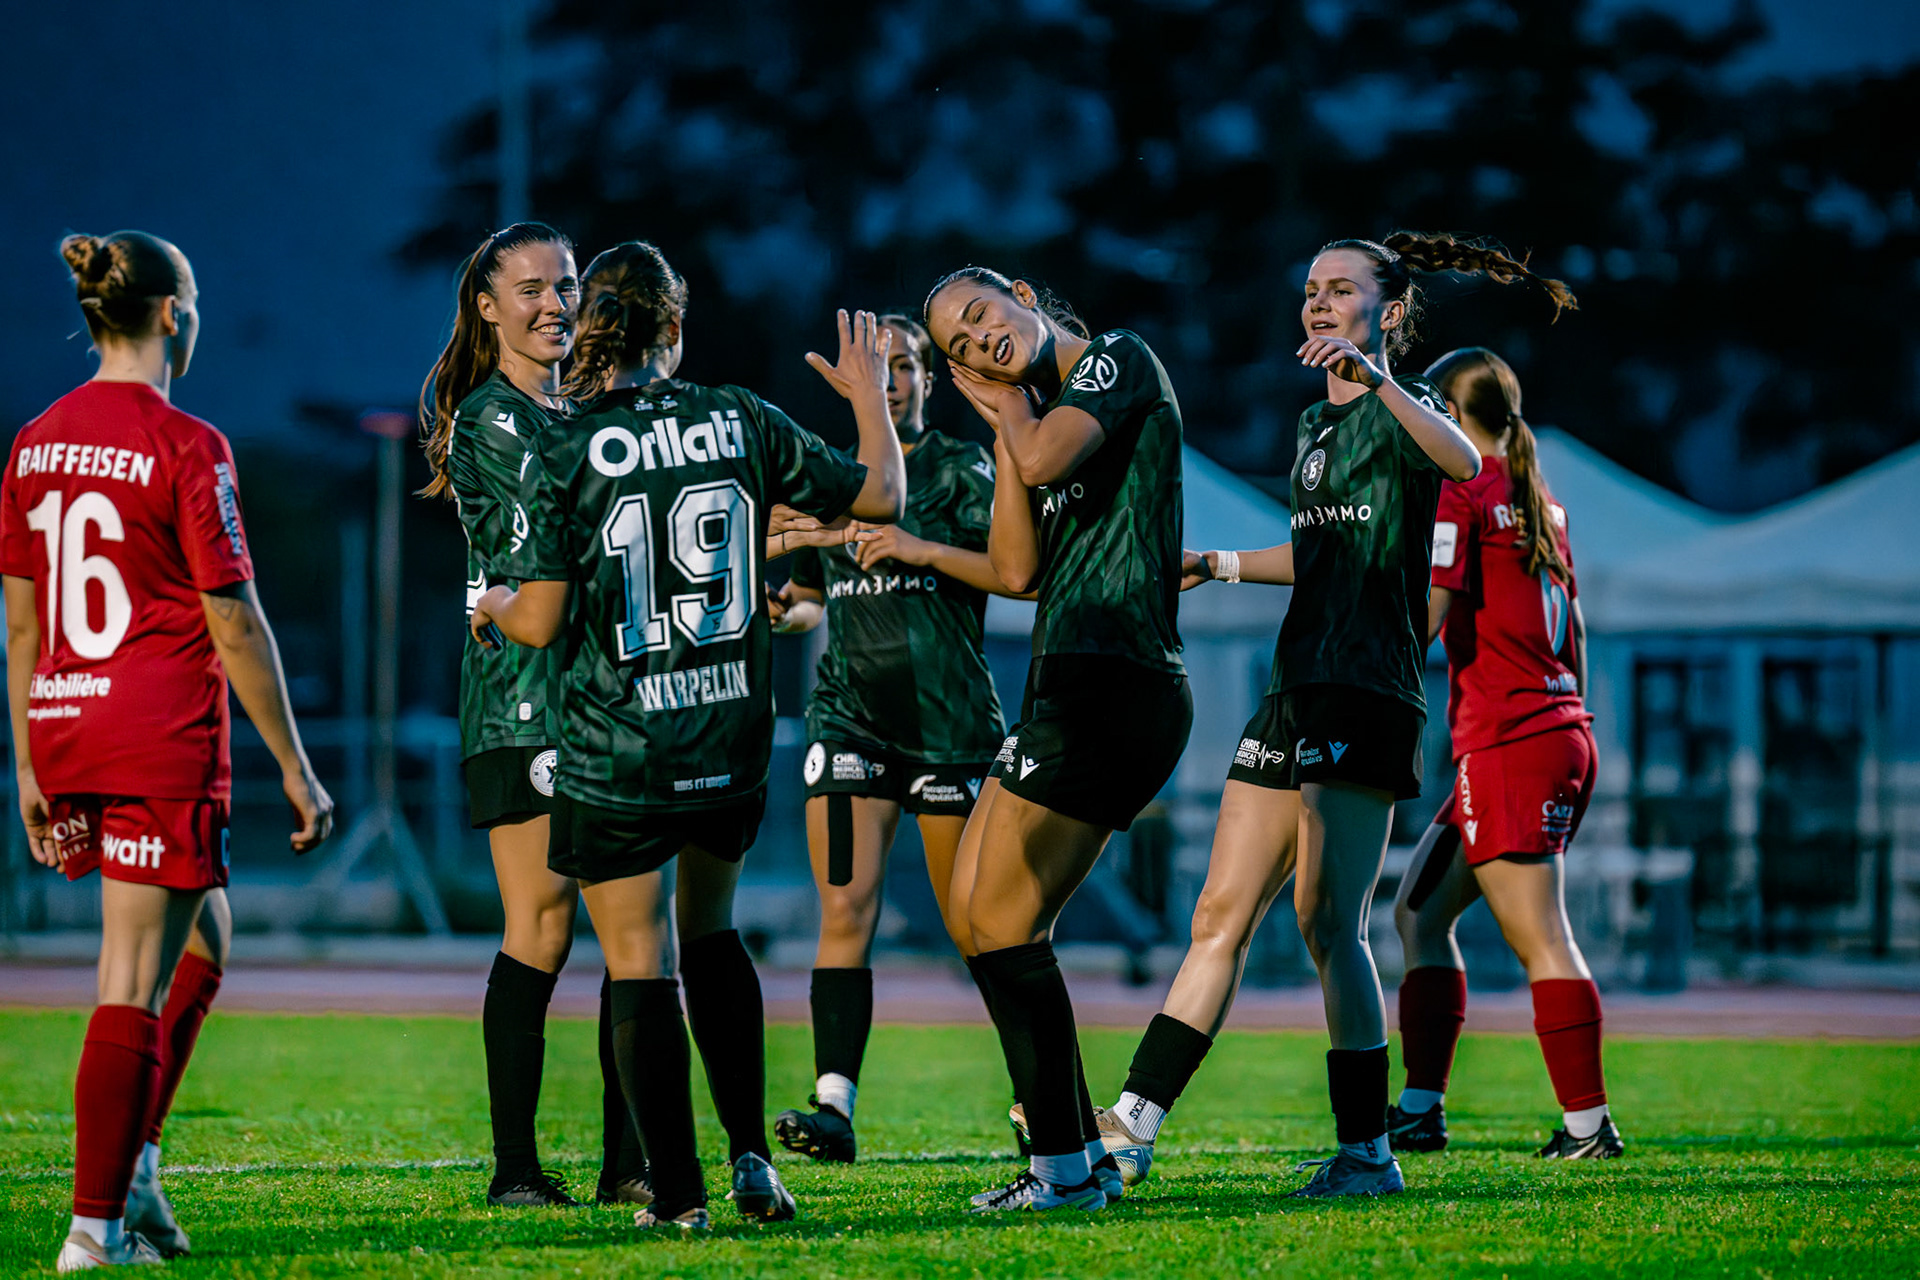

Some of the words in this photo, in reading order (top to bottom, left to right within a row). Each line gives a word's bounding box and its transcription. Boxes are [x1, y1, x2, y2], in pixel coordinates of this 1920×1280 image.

[17, 442, 154, 487] RAIFFEISEN
[588, 409, 746, 477] Orllati
[26, 490, 133, 660] 16
[602, 478, 757, 661] 19
[634, 660, 750, 712] WARPELIN
[52, 814, 89, 841] ON
